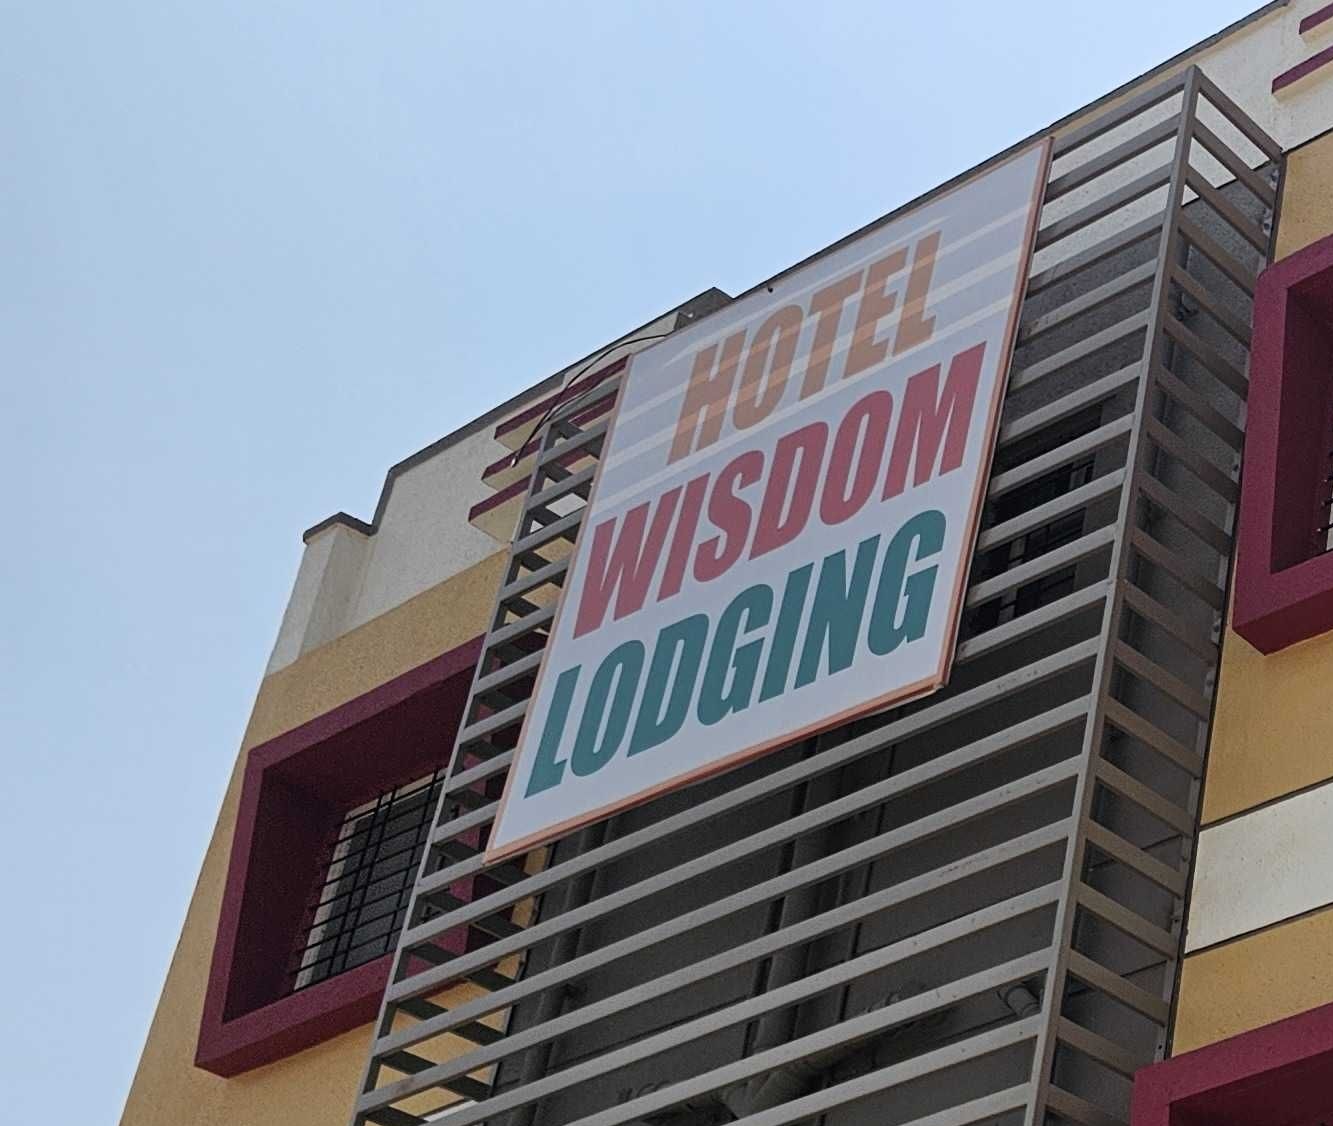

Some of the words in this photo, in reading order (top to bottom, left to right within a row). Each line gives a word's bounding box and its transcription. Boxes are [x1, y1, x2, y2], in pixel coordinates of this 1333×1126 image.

[573, 341, 988, 639] WISDOM
[667, 231, 942, 465] HOTEL
[524, 509, 947, 799] LODGING
